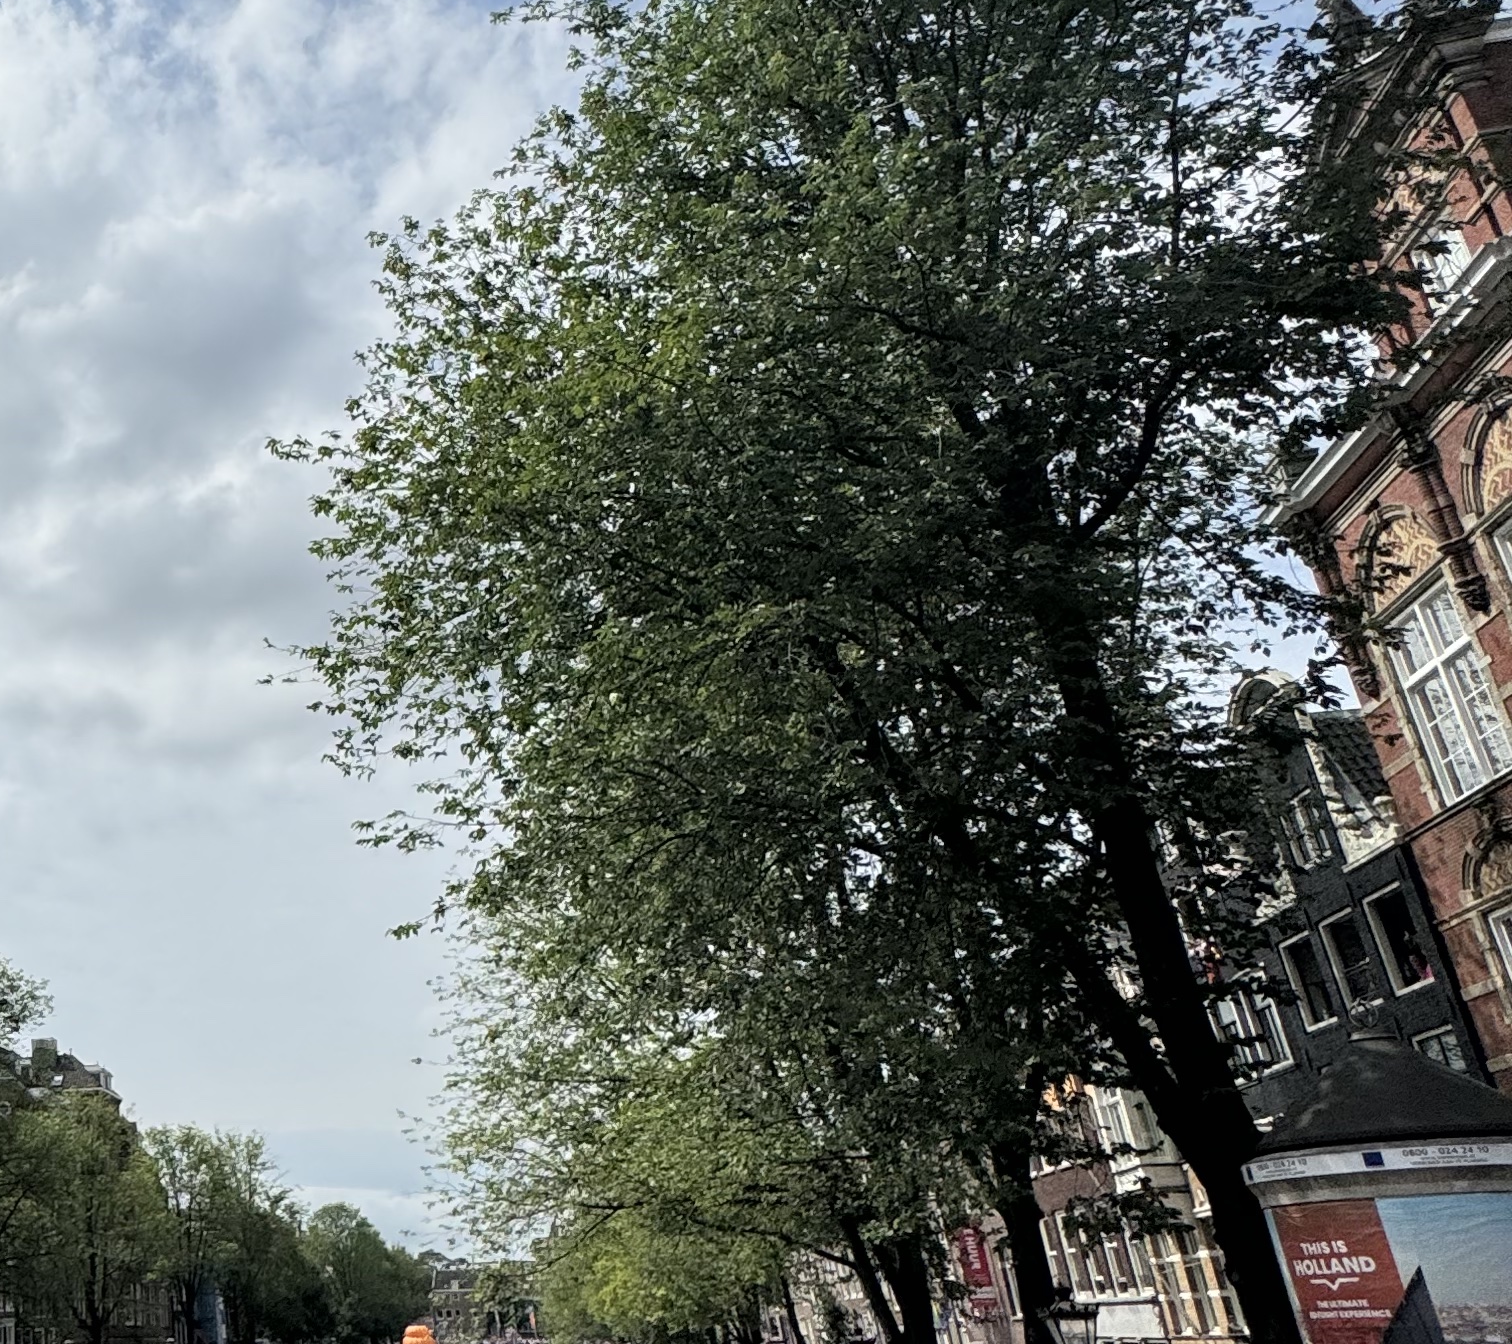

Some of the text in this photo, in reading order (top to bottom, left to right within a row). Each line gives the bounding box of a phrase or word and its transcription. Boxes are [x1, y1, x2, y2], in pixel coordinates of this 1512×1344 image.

[1300, 1240, 1348, 1256] THIS IS
[1293, 1256, 1376, 1276] HOLLAND
